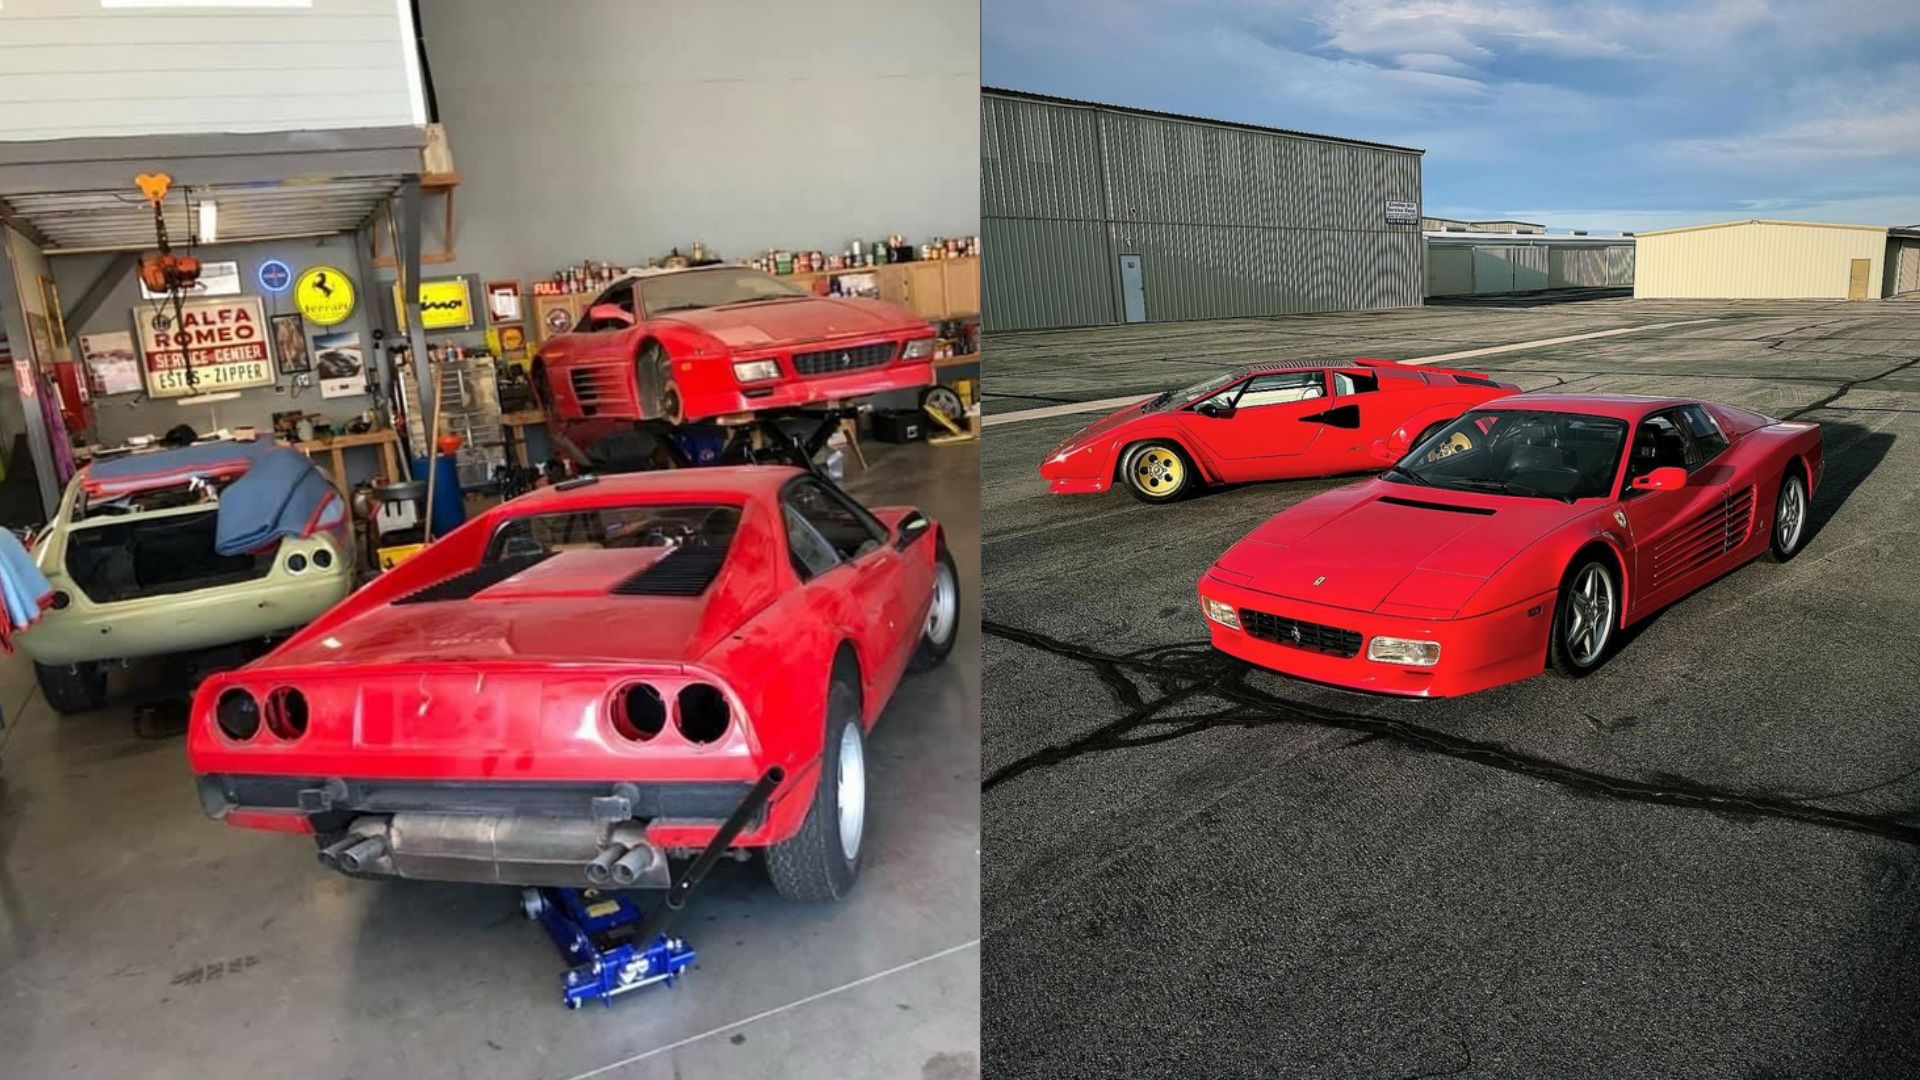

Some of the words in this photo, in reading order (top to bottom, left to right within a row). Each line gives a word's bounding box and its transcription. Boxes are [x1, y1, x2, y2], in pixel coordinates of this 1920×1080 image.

[420, 295, 462, 311] ino
[184, 308, 251, 328] ALFA
[155, 325, 254, 347] ROMEO
[155, 350, 210, 368] SERVCE
[215, 344, 262, 363] CENTER
[215, 364, 263, 383] ZIPPER
